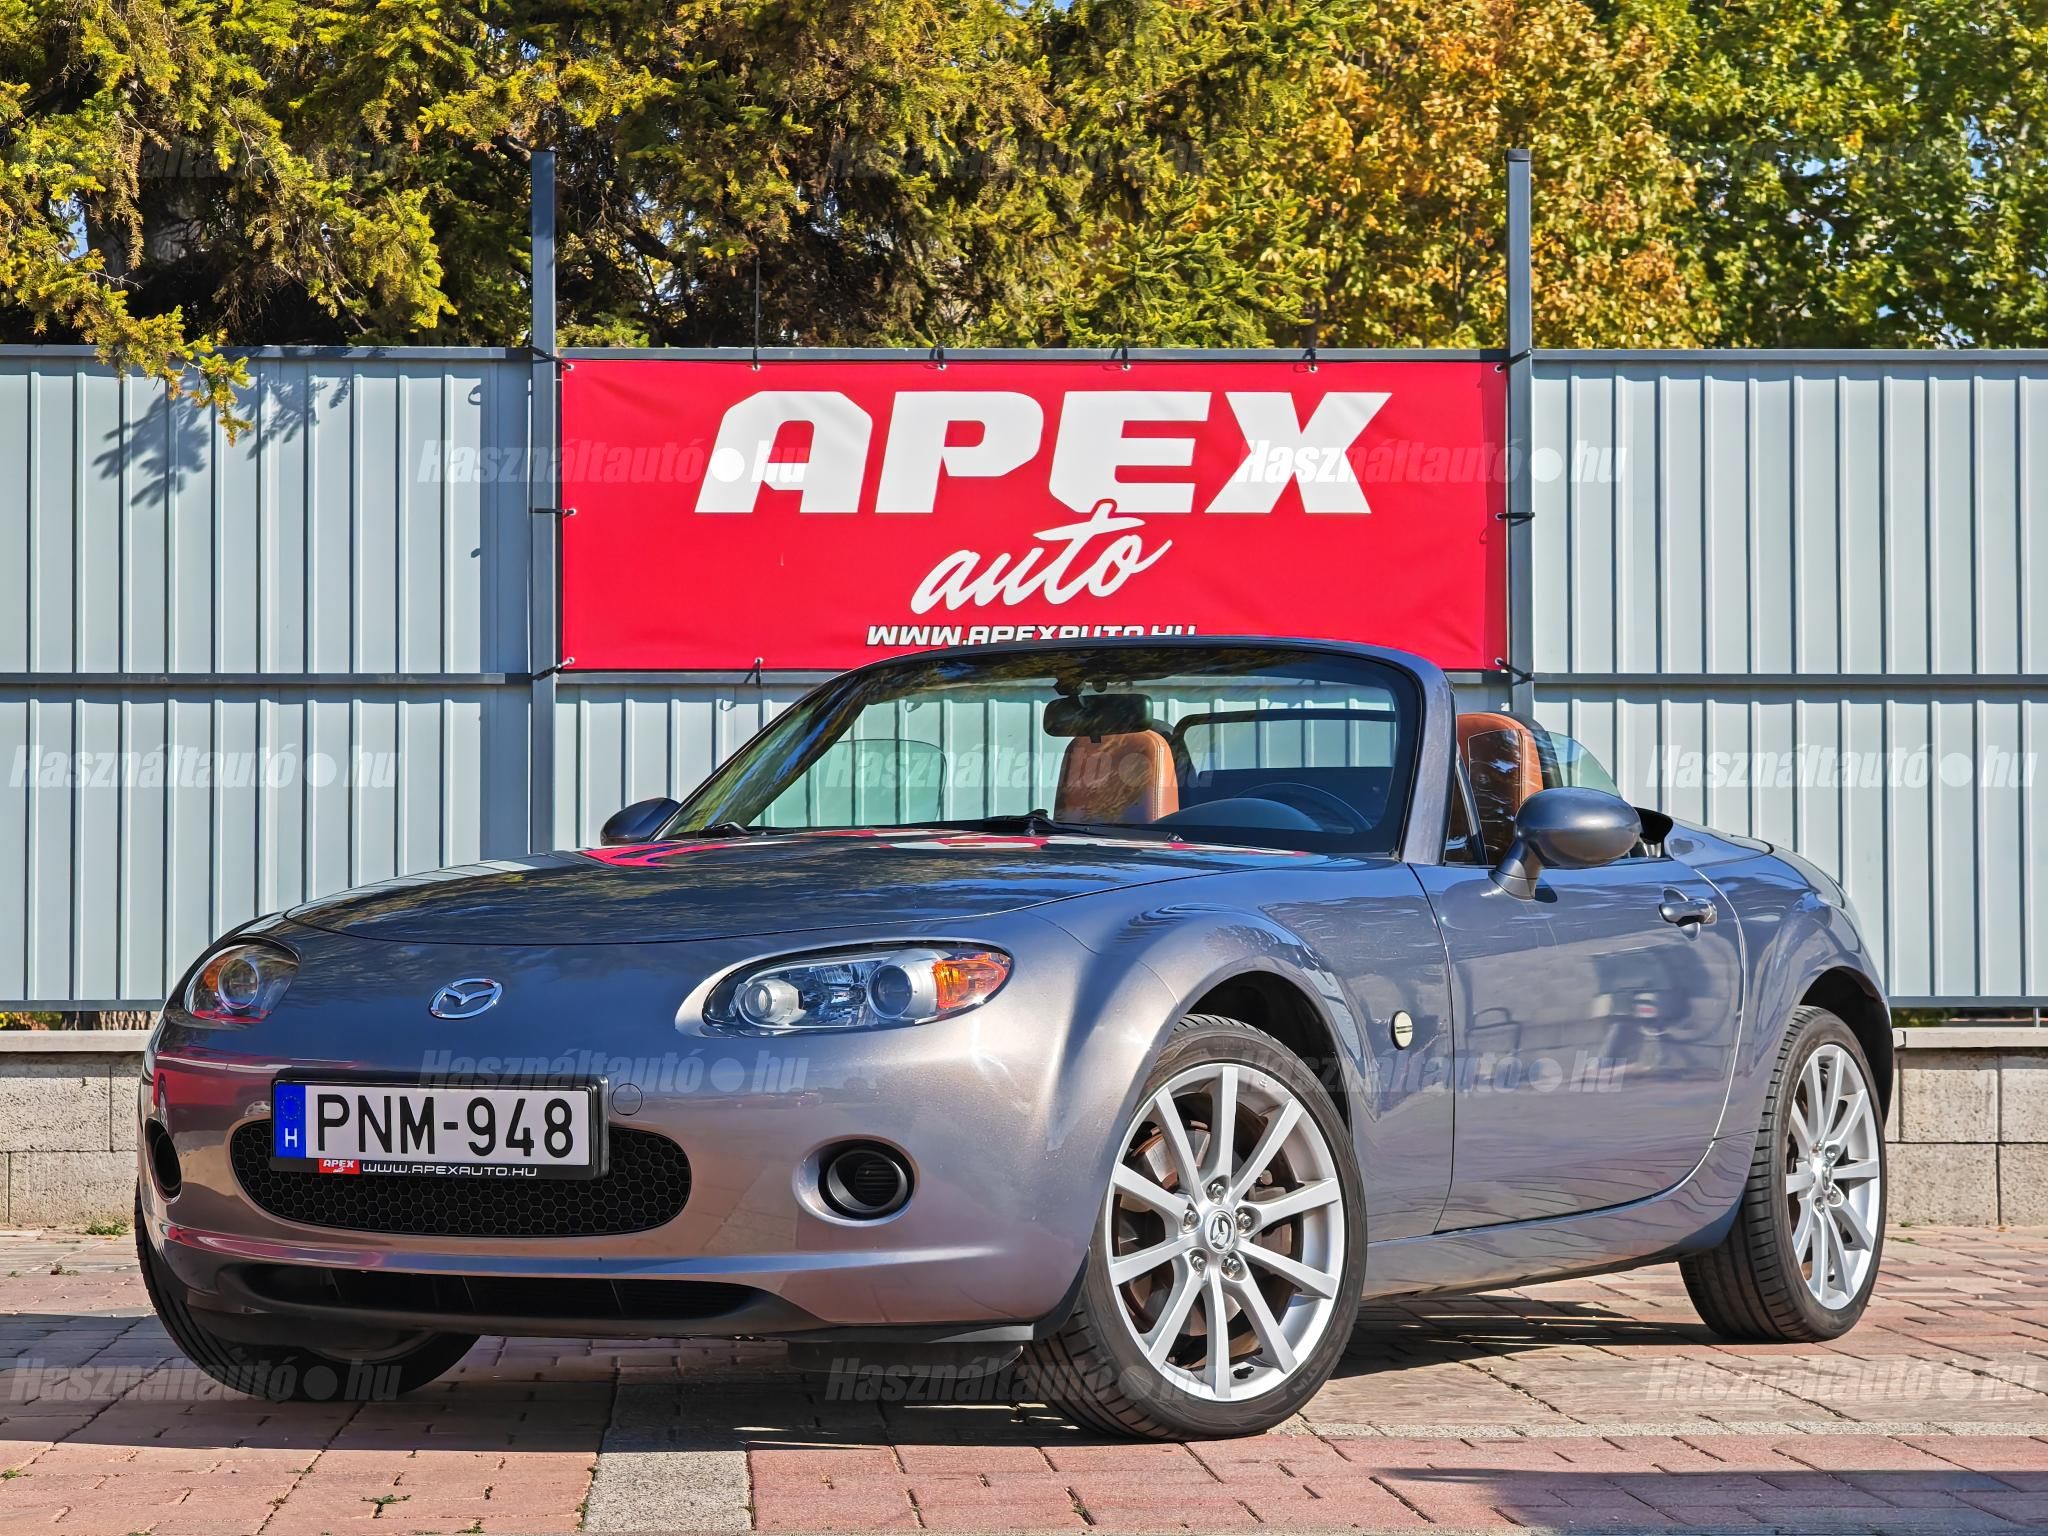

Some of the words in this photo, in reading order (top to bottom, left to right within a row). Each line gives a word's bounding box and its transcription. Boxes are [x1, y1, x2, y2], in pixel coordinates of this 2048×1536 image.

[694, 391, 1393, 515] APEX
[910, 502, 1173, 615] auto
[866, 625, 1196, 646] WWW.APEXAUTOH
[284, 1127, 298, 1148] H
[316, 1093, 574, 1159] PNM-948
[322, 1159, 355, 1169] APEX
